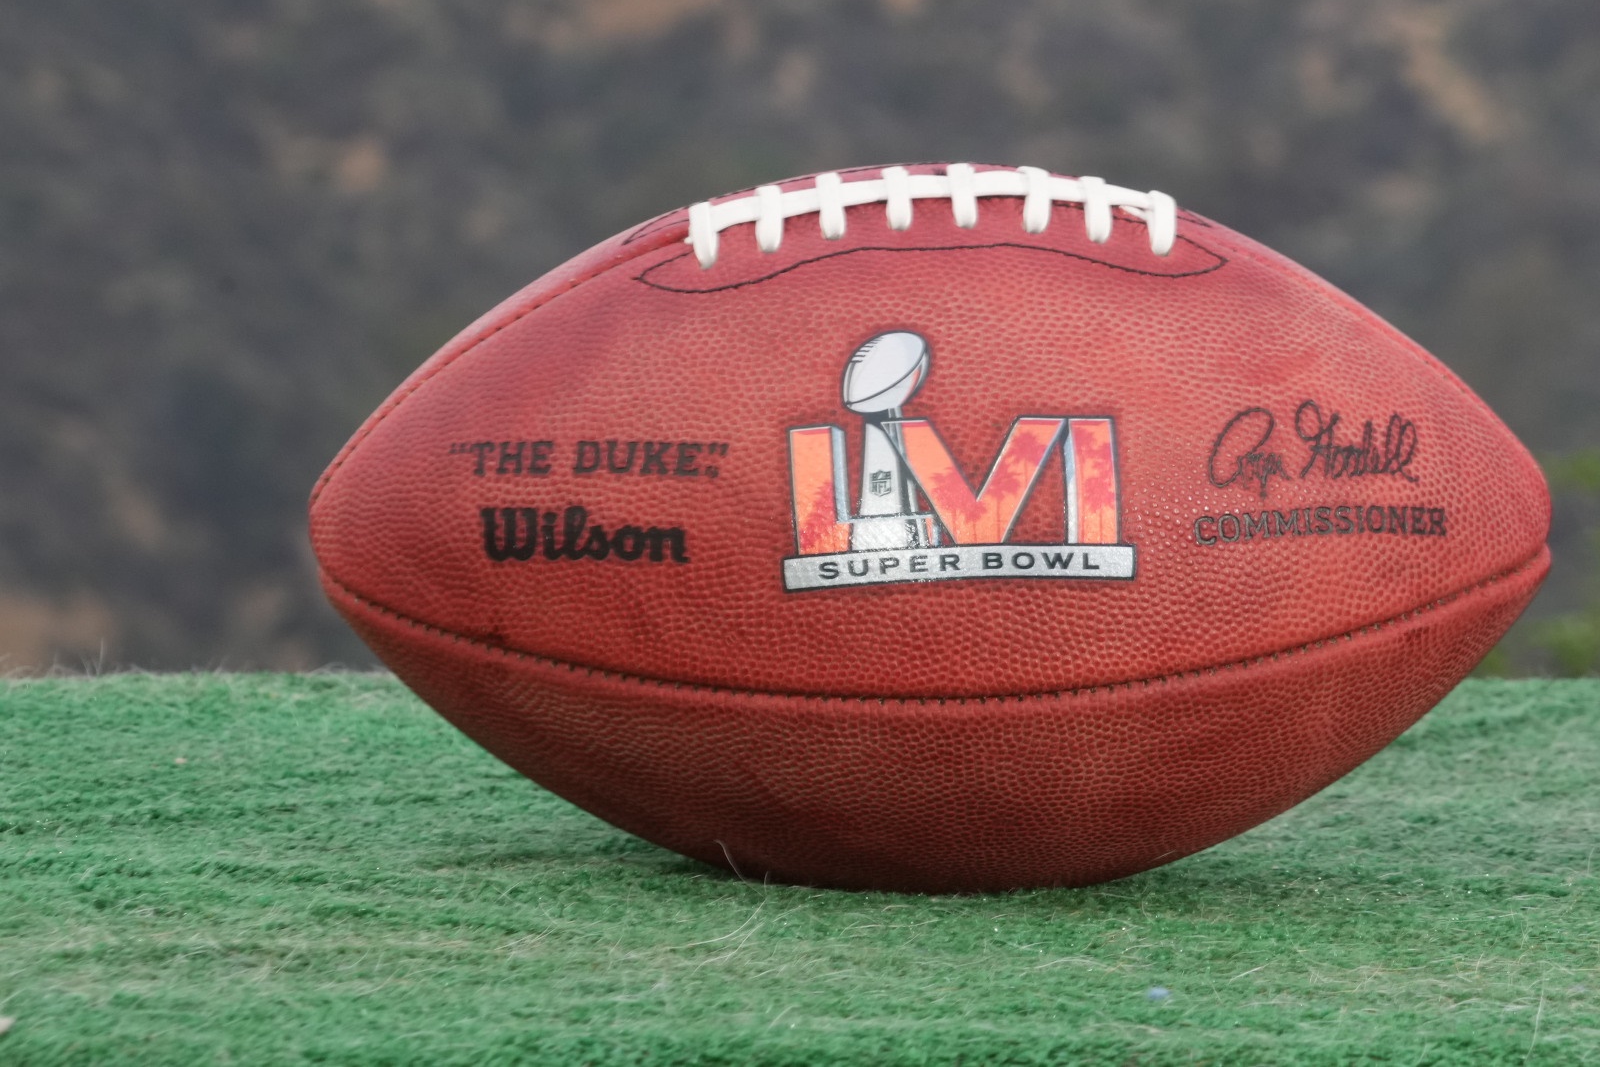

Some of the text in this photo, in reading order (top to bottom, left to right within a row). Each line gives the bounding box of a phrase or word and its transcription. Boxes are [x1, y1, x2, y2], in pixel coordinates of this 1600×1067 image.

[480, 505, 691, 564] Wilson
[1193, 504, 1449, 547] COMMISSIONER
[818, 550, 1101, 581] SUPER BOWL
